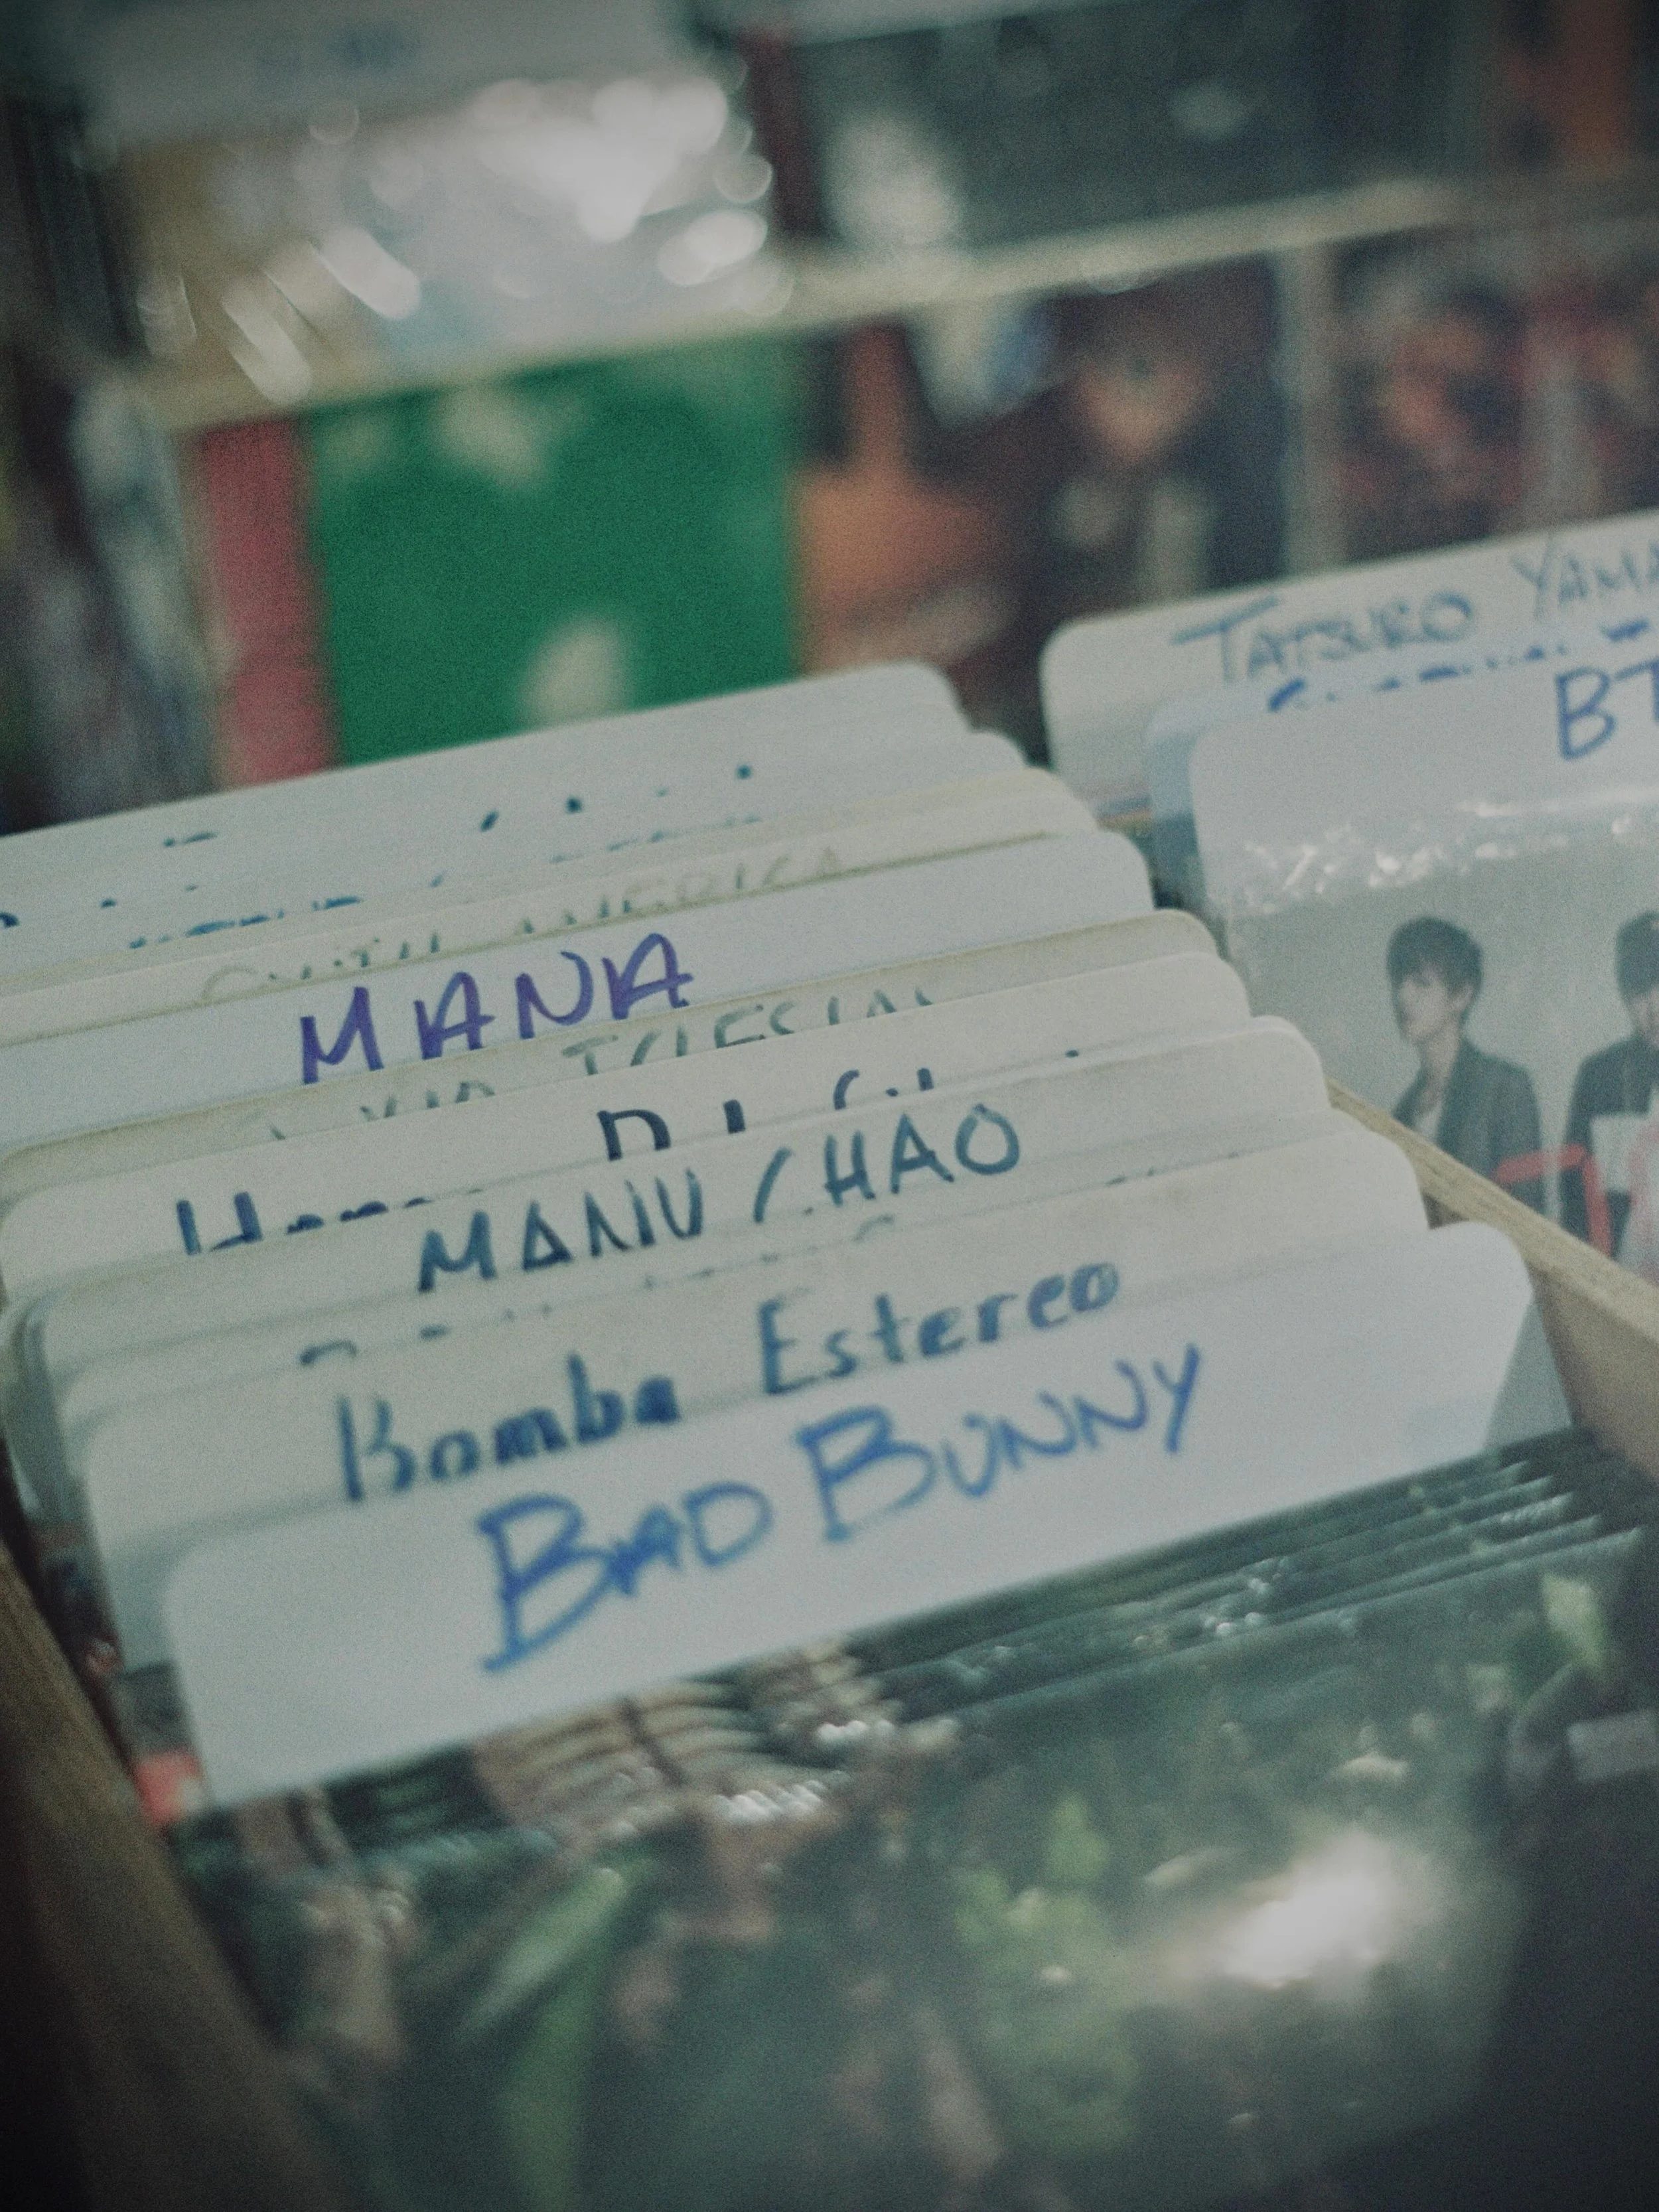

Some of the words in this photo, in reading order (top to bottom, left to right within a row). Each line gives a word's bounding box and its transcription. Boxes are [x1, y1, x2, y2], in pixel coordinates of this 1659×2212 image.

[299, 932, 694, 1085] MANA
[417, 1166, 704, 1293] MANU
[757, 1261, 1119, 1396] Estereo
[476, 1481, 775, 1676] BAD
[796, 1343, 1202, 1545] BUNNY
